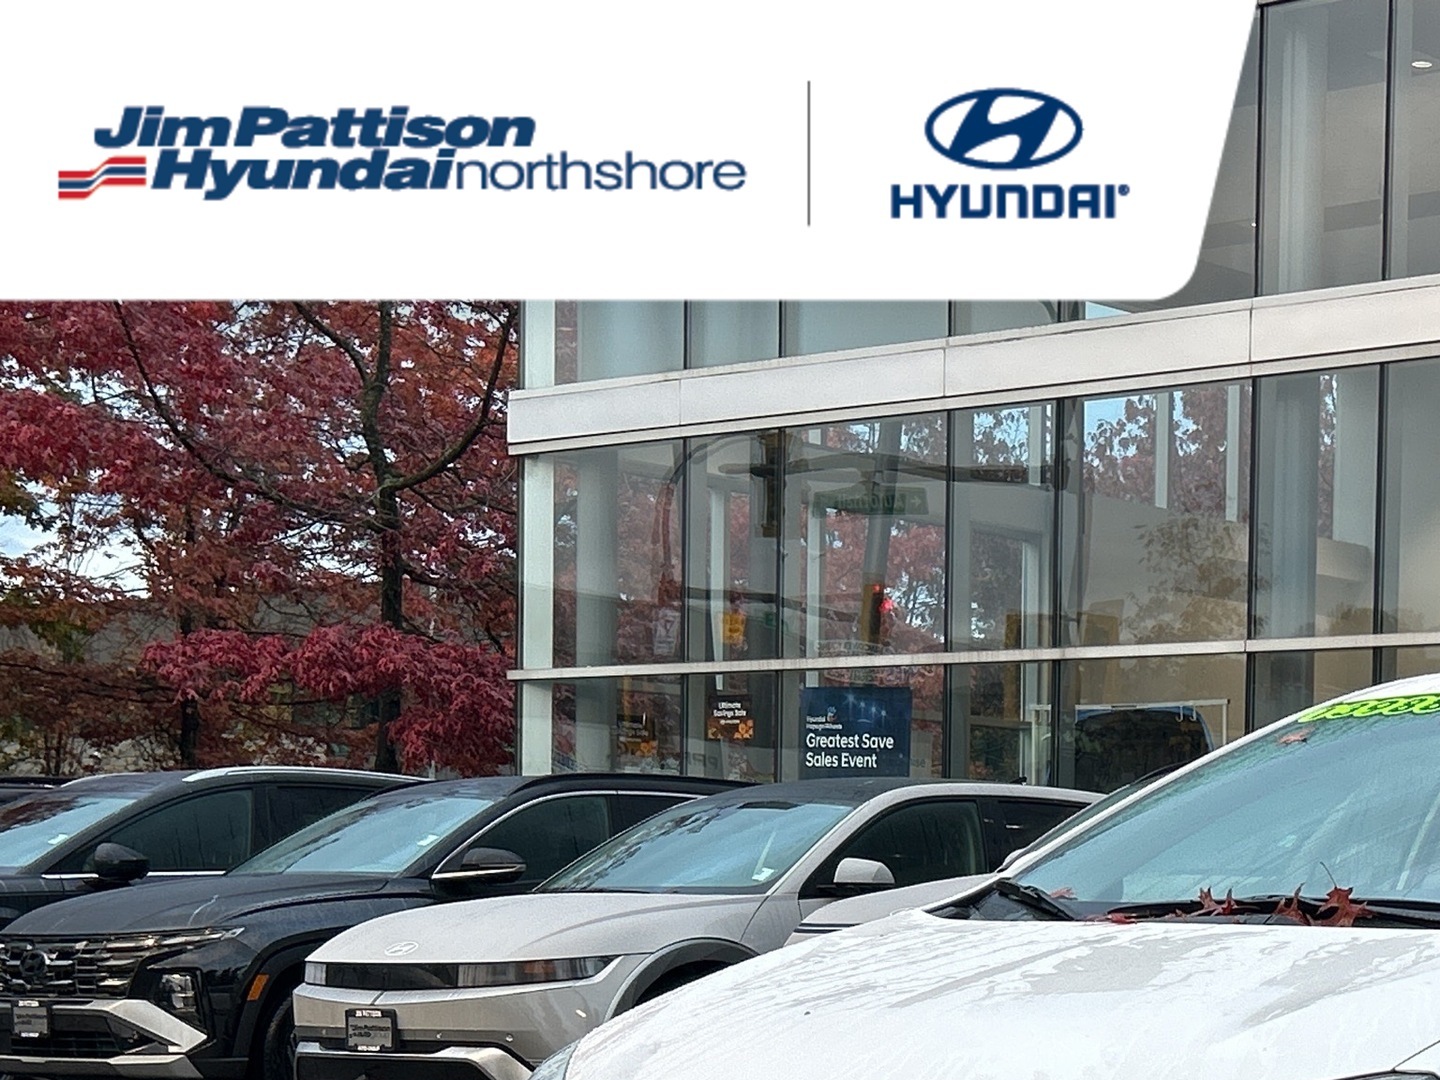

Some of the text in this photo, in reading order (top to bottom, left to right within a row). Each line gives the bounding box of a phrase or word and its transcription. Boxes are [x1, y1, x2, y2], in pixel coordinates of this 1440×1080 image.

[806, 733, 894, 750] Greatest Save
[805, 751, 877, 769] Sales Event
